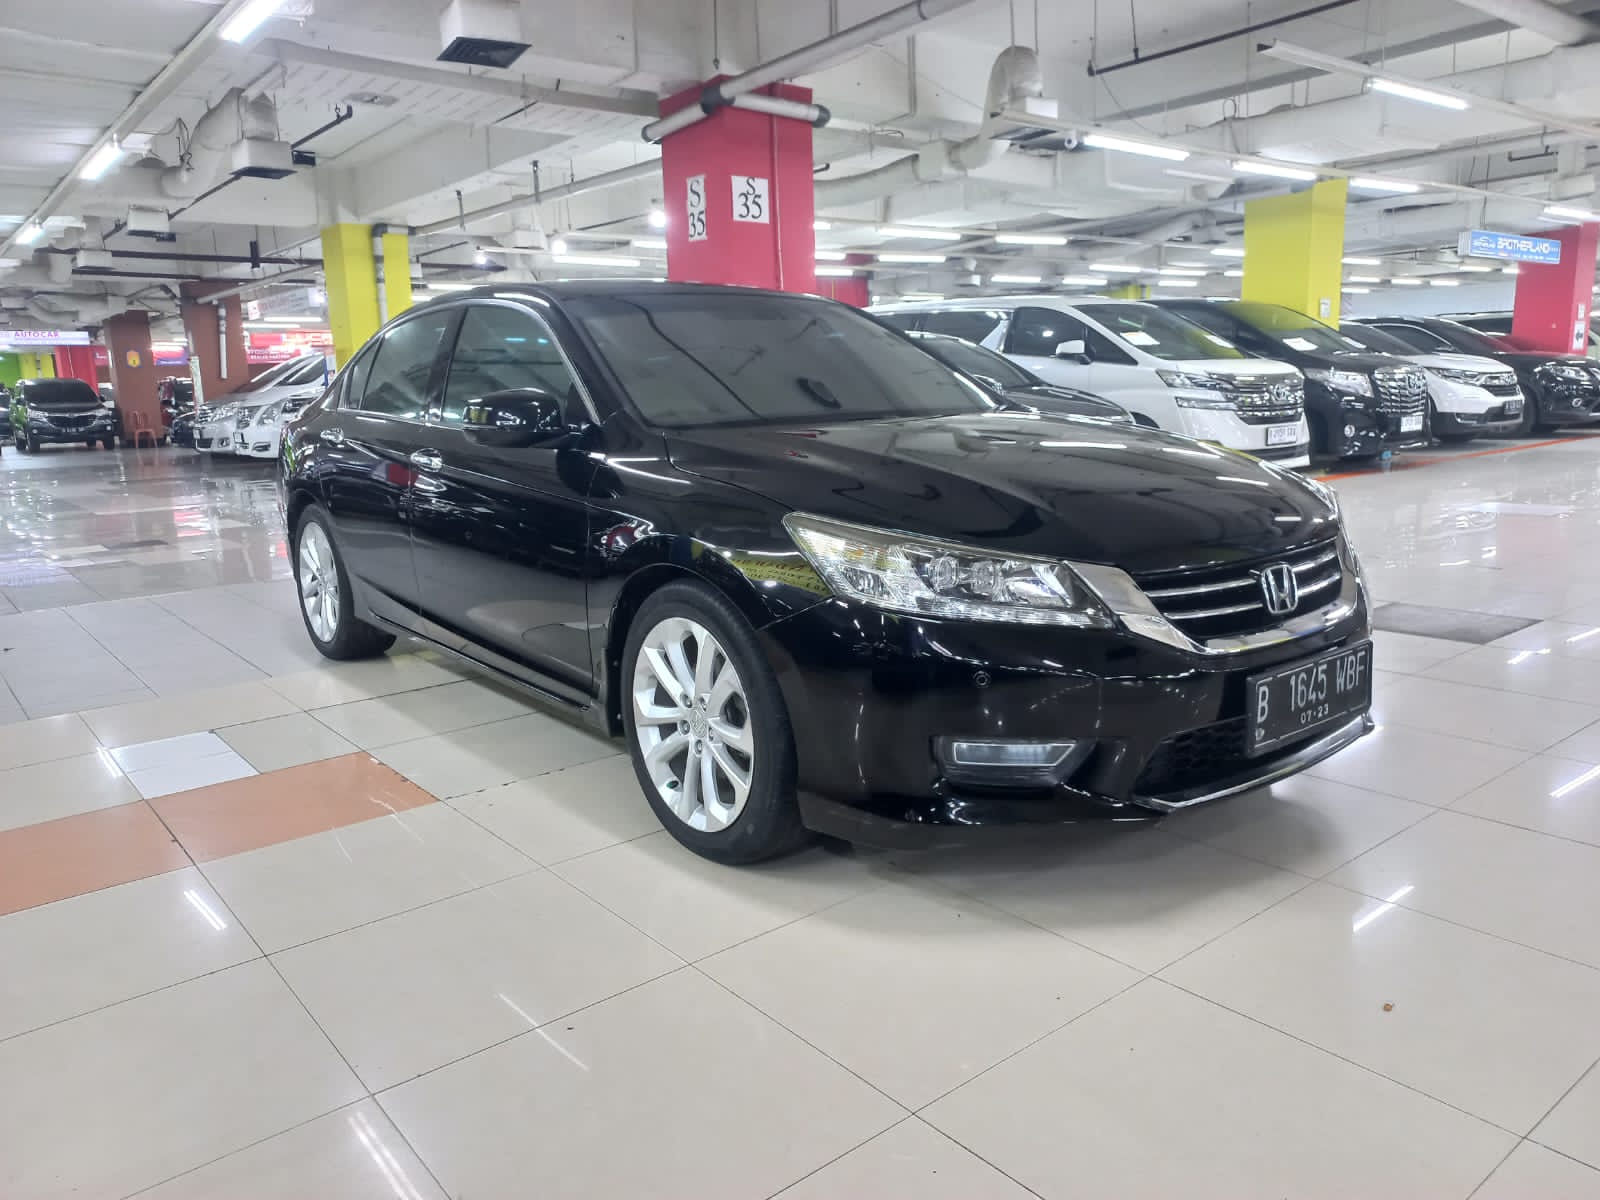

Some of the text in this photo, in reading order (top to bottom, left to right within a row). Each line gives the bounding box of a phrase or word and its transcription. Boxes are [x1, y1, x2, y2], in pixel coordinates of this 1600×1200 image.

[690, 179, 701, 208] S
[746, 176, 756, 196] S
[738, 192, 762, 219] 35
[689, 210, 705, 238] 35
[1257, 651, 1366, 724] B 1645 WBF
